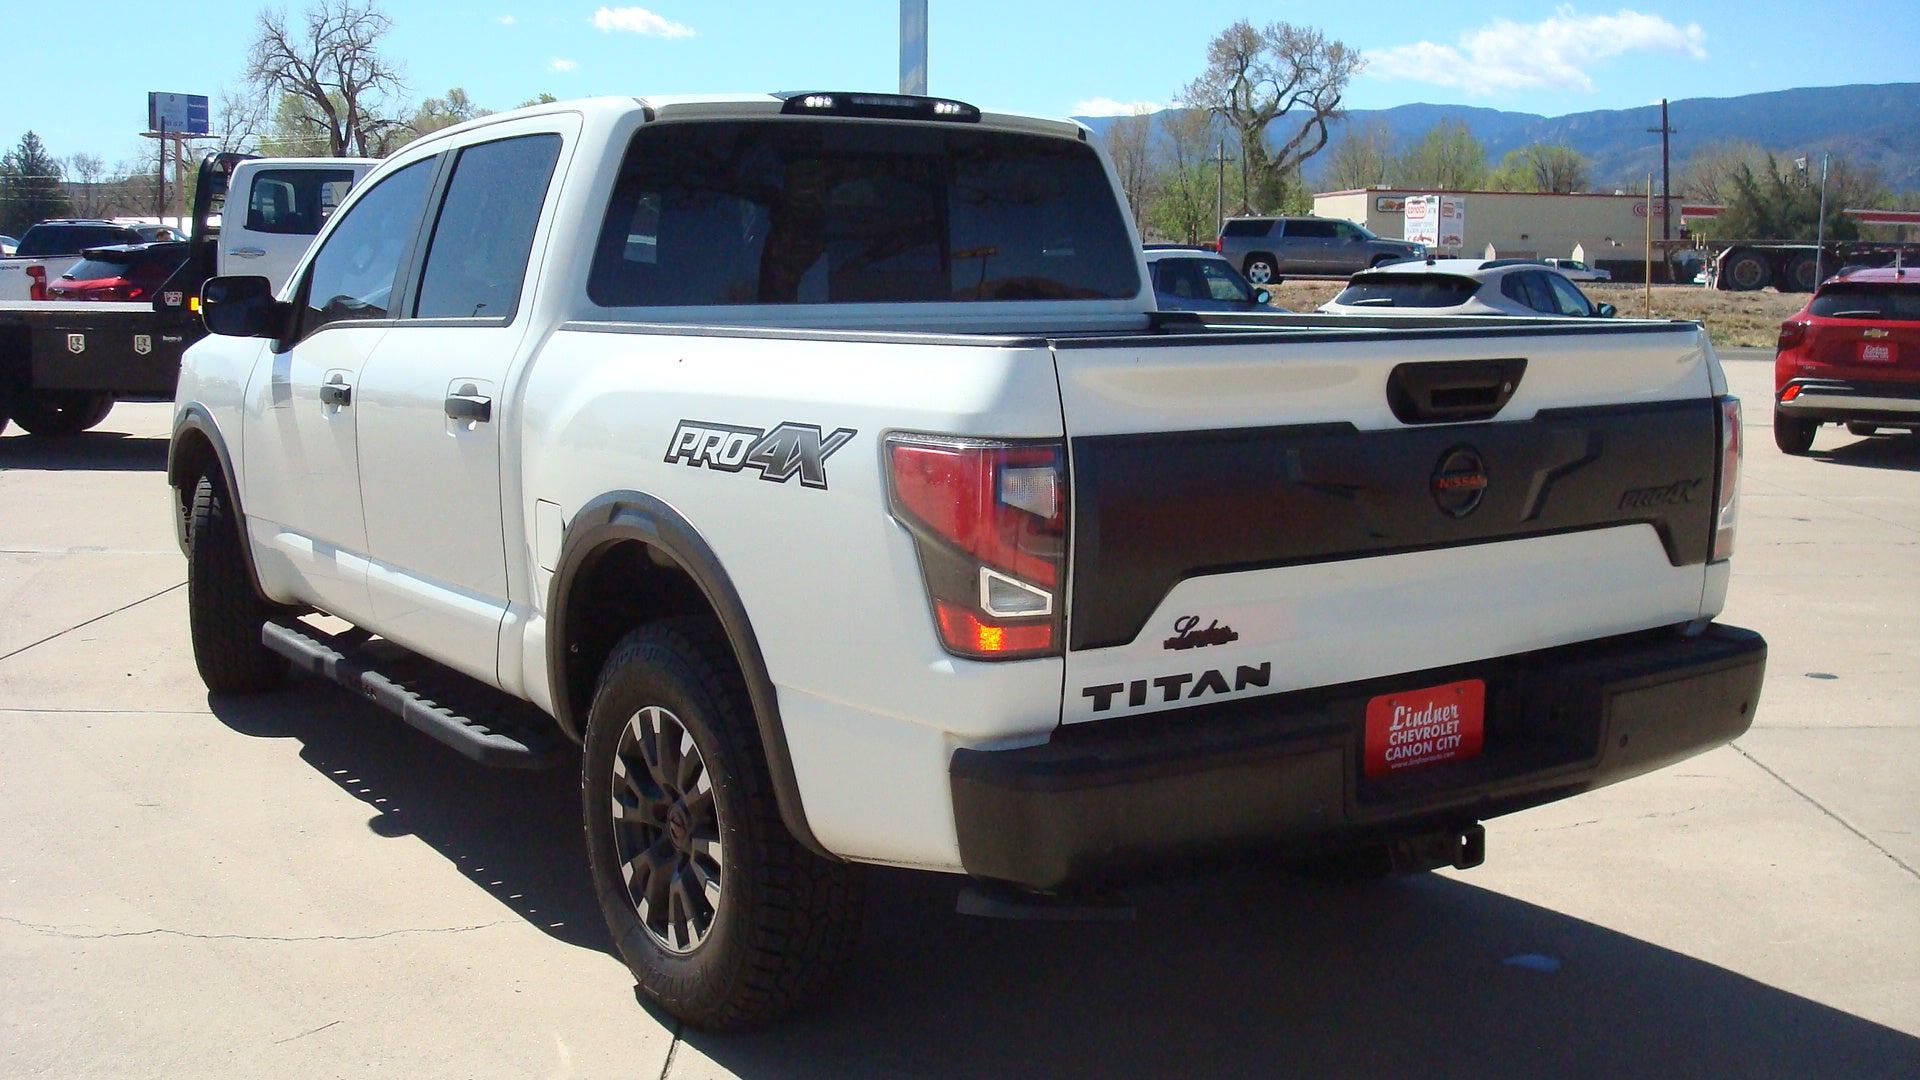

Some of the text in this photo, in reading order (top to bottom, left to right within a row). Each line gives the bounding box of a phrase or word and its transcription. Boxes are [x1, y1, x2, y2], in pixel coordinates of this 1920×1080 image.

[664, 419, 858, 490] PRO4X
[1439, 475, 1485, 489] NISSAN
[1082, 662, 1271, 712] TITAN
[1389, 702, 1459, 731] Lindner
[1389, 720, 1459, 746] CHEVROLET
[1385, 734, 1462, 761] CANON CITY
